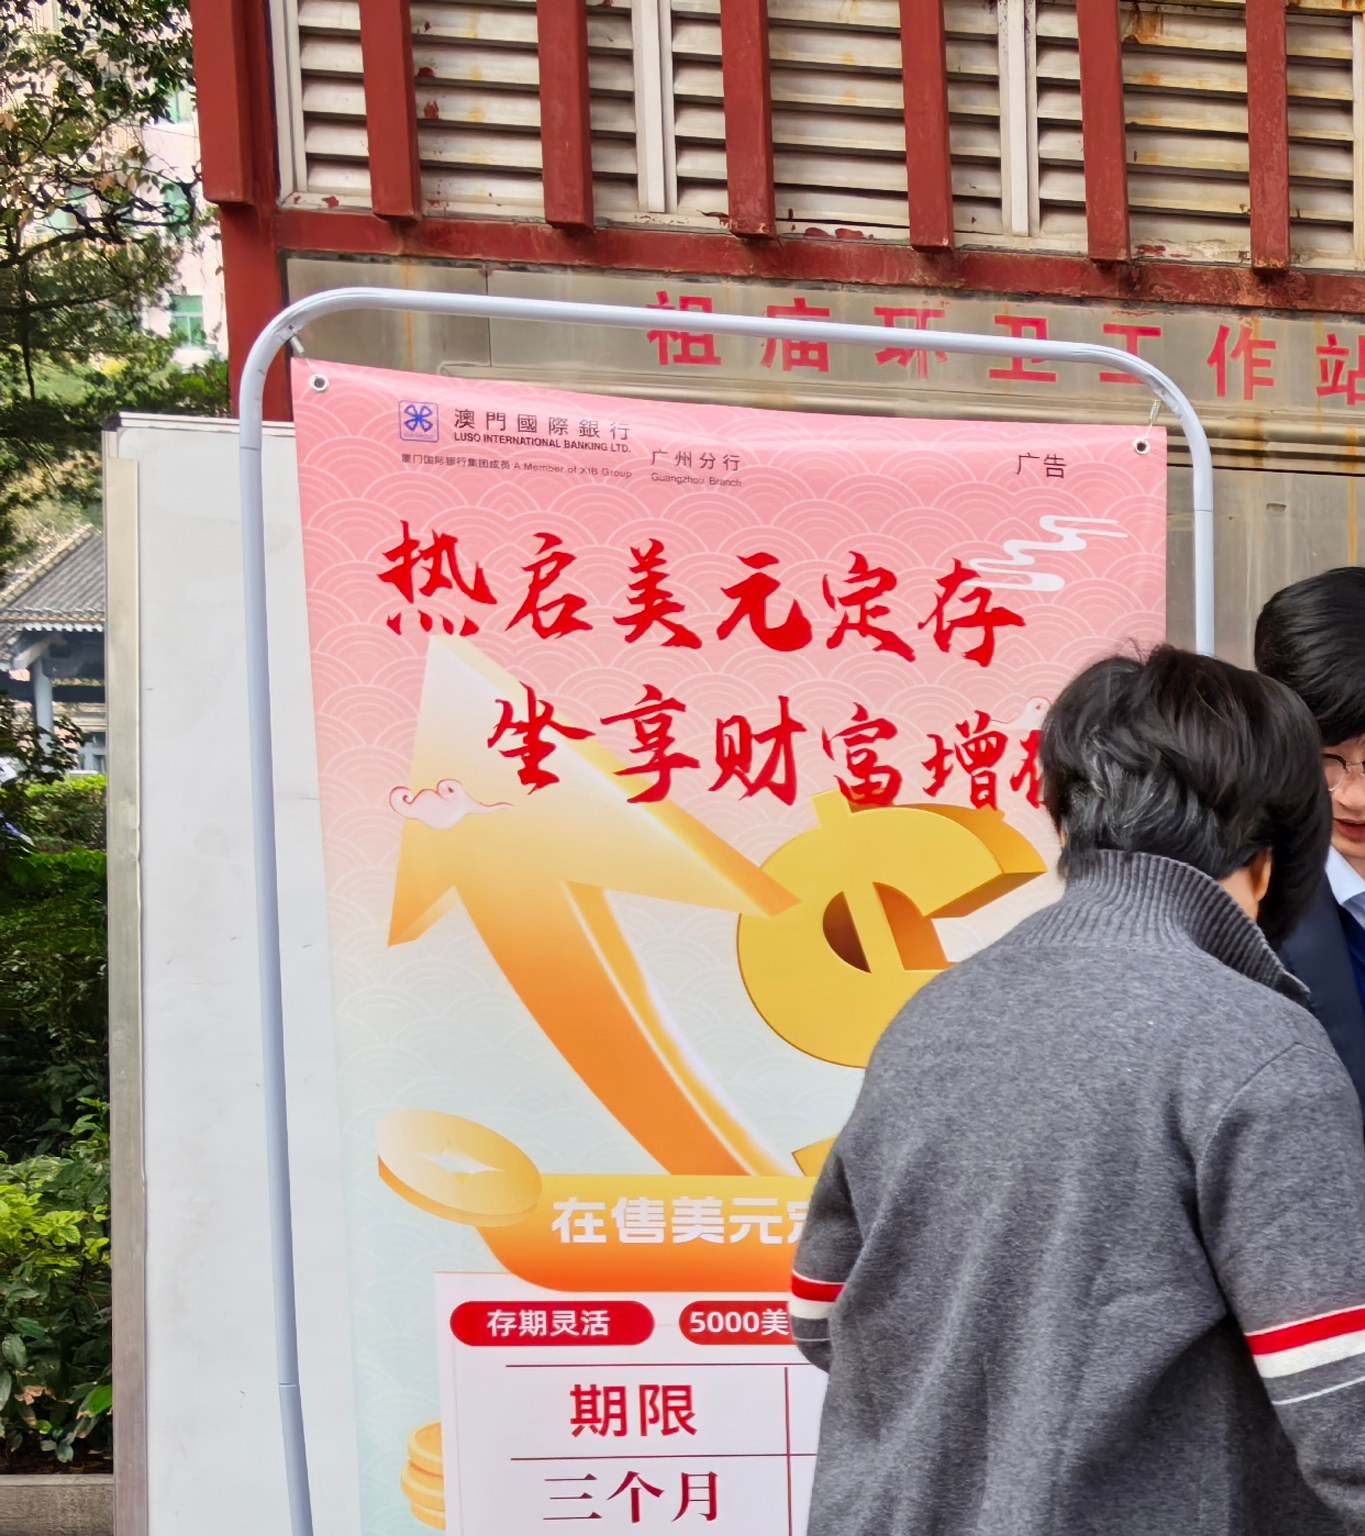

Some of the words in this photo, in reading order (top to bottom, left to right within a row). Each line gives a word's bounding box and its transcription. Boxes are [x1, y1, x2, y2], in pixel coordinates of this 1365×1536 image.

[454, 408, 632, 441] 澳門國際銀行
[454, 432, 481, 442] LUSO
[483, 434, 562, 448] INTERNATIONAL
[563, 440, 608, 451] BANKING
[610, 443, 631, 453] LTD.
[401, 453, 510, 470] 厦门国际银行集团成员
[523, 463, 564, 473] Member
[567, 465, 577, 473] of
[580, 466, 599, 475] XIB
[601, 468, 633, 478] Group
[650, 449, 742, 472] 广州分行
[1016, 452, 1067, 479] 广告
[650, 472, 706, 486] Guangzhou
[709, 476, 742, 488] Branch
[376, 519, 1026, 667] 热启美元定存
[486, 1309, 610, 1338] 存期灵活
[689, 1308, 789, 1336] 5000美
[569, 1383, 698, 1438] 期限
[543, 1470, 719, 1523] 三个月
